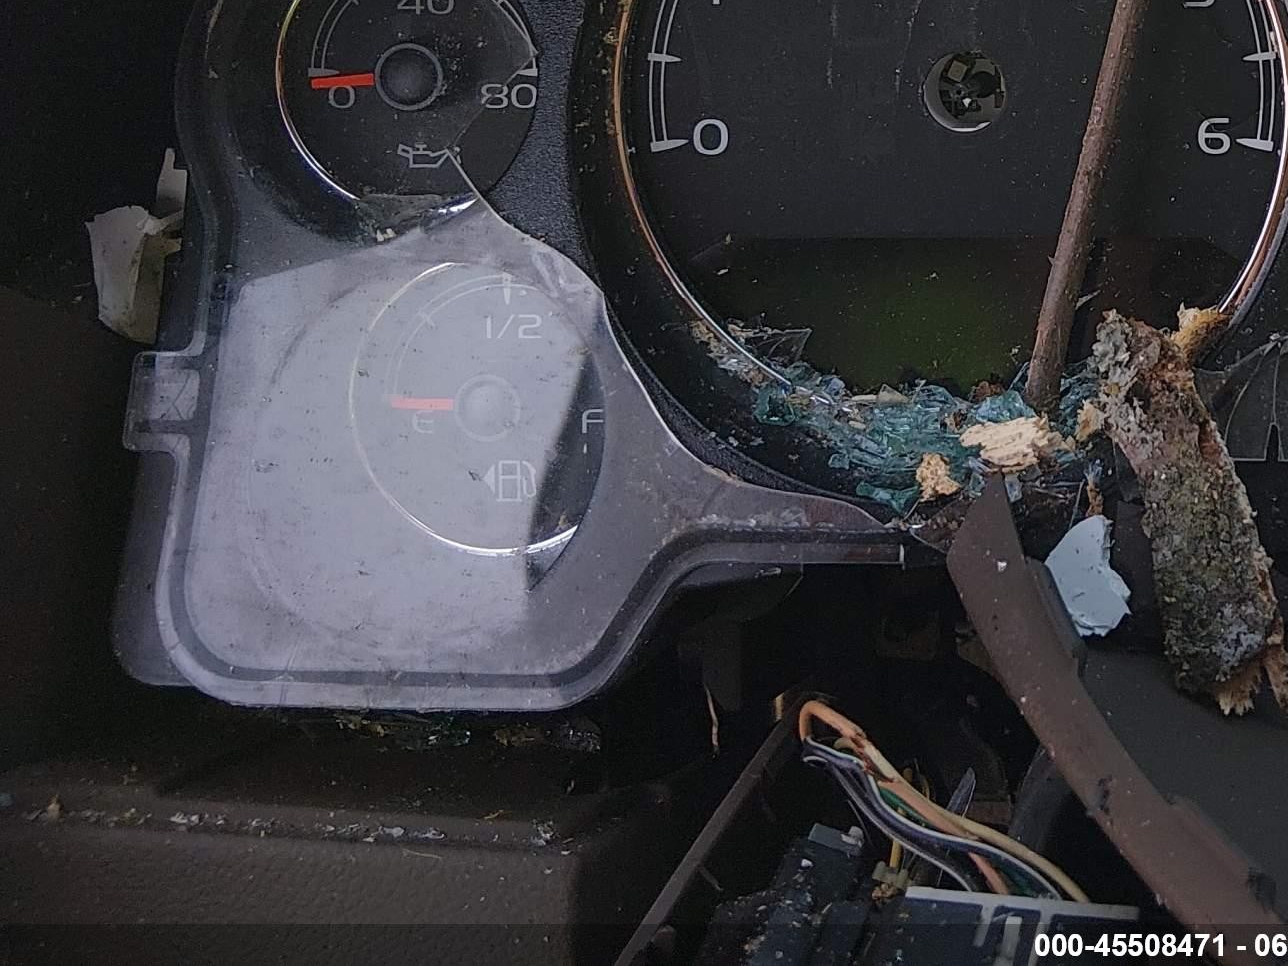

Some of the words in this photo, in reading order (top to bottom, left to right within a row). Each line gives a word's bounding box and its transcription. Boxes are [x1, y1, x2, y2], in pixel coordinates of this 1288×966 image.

[327, 85, 355, 109] 0
[480, 83, 537, 109] 80
[693, 119, 729, 155] 0
[1197, 118, 1231, 155] 6
[486, 315, 542, 339] 1/2
[412, 410, 433, 433] E
[582, 409, 604, 434] F
